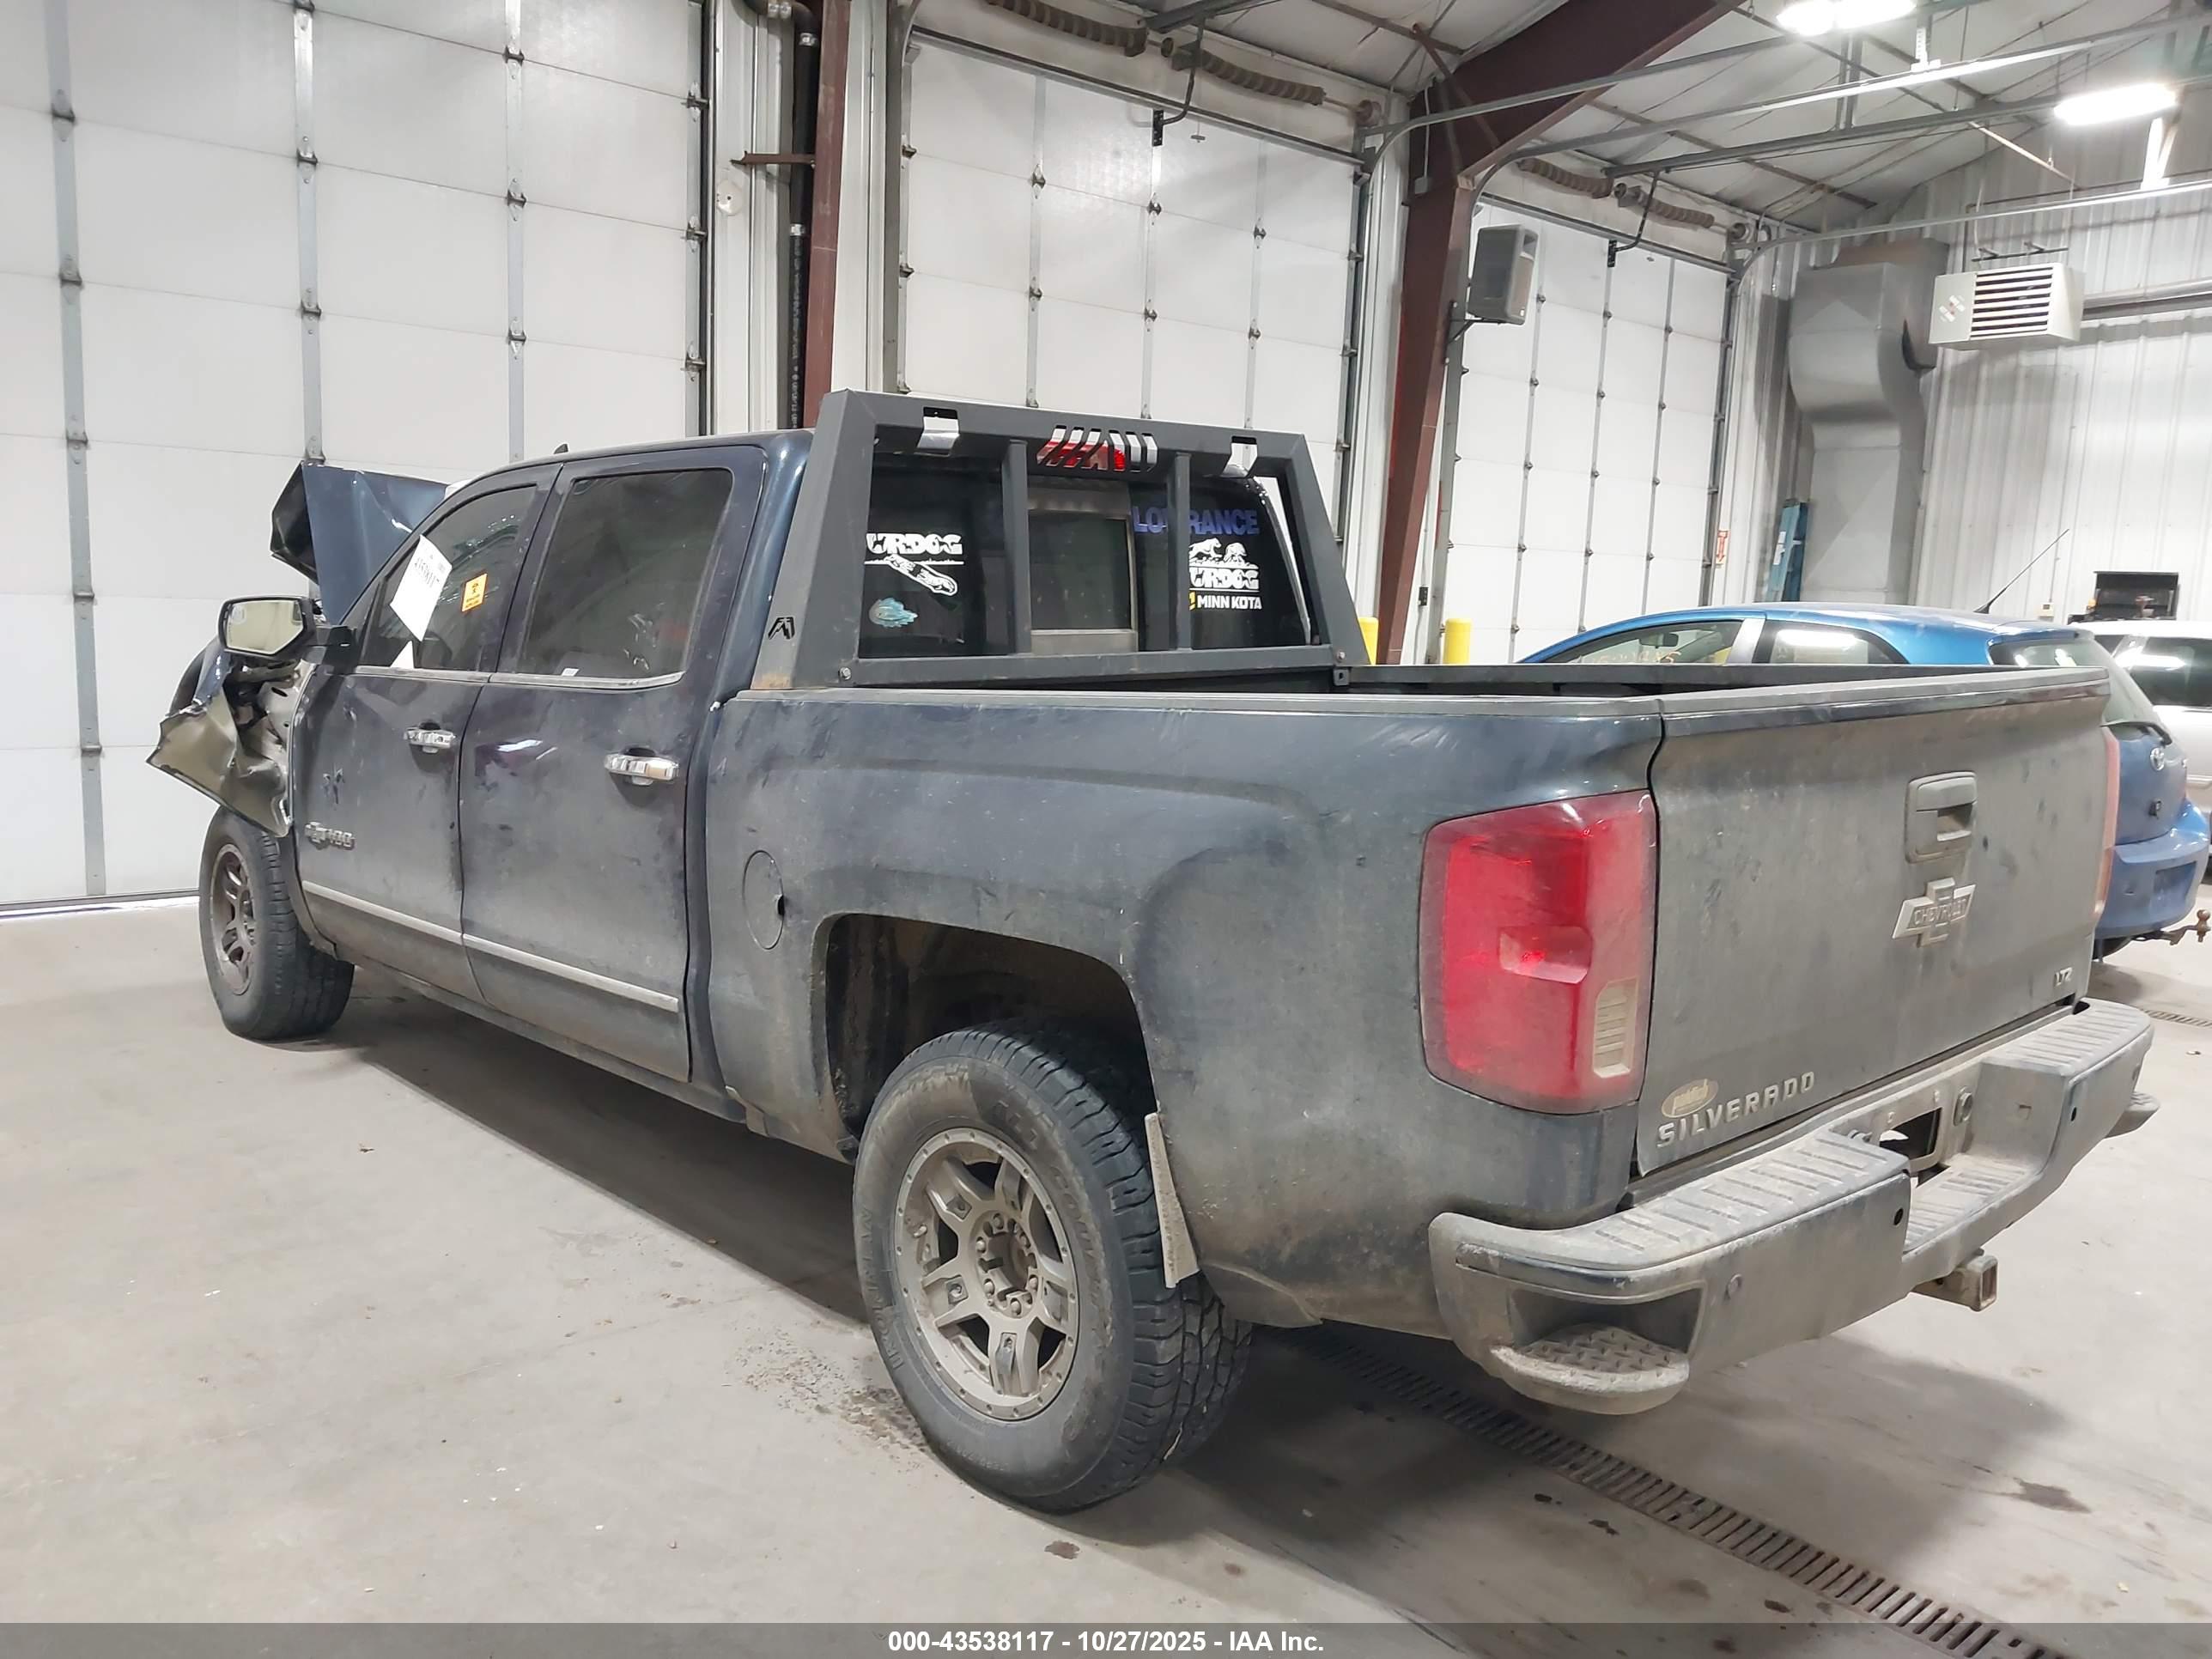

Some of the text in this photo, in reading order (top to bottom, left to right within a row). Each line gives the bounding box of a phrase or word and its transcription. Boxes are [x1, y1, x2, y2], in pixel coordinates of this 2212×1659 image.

[1197, 594, 1262, 611] MINN KOTA
[2055, 967, 2074, 987] LTZ
[1656, 1071, 1814, 1148] SILVERADO
